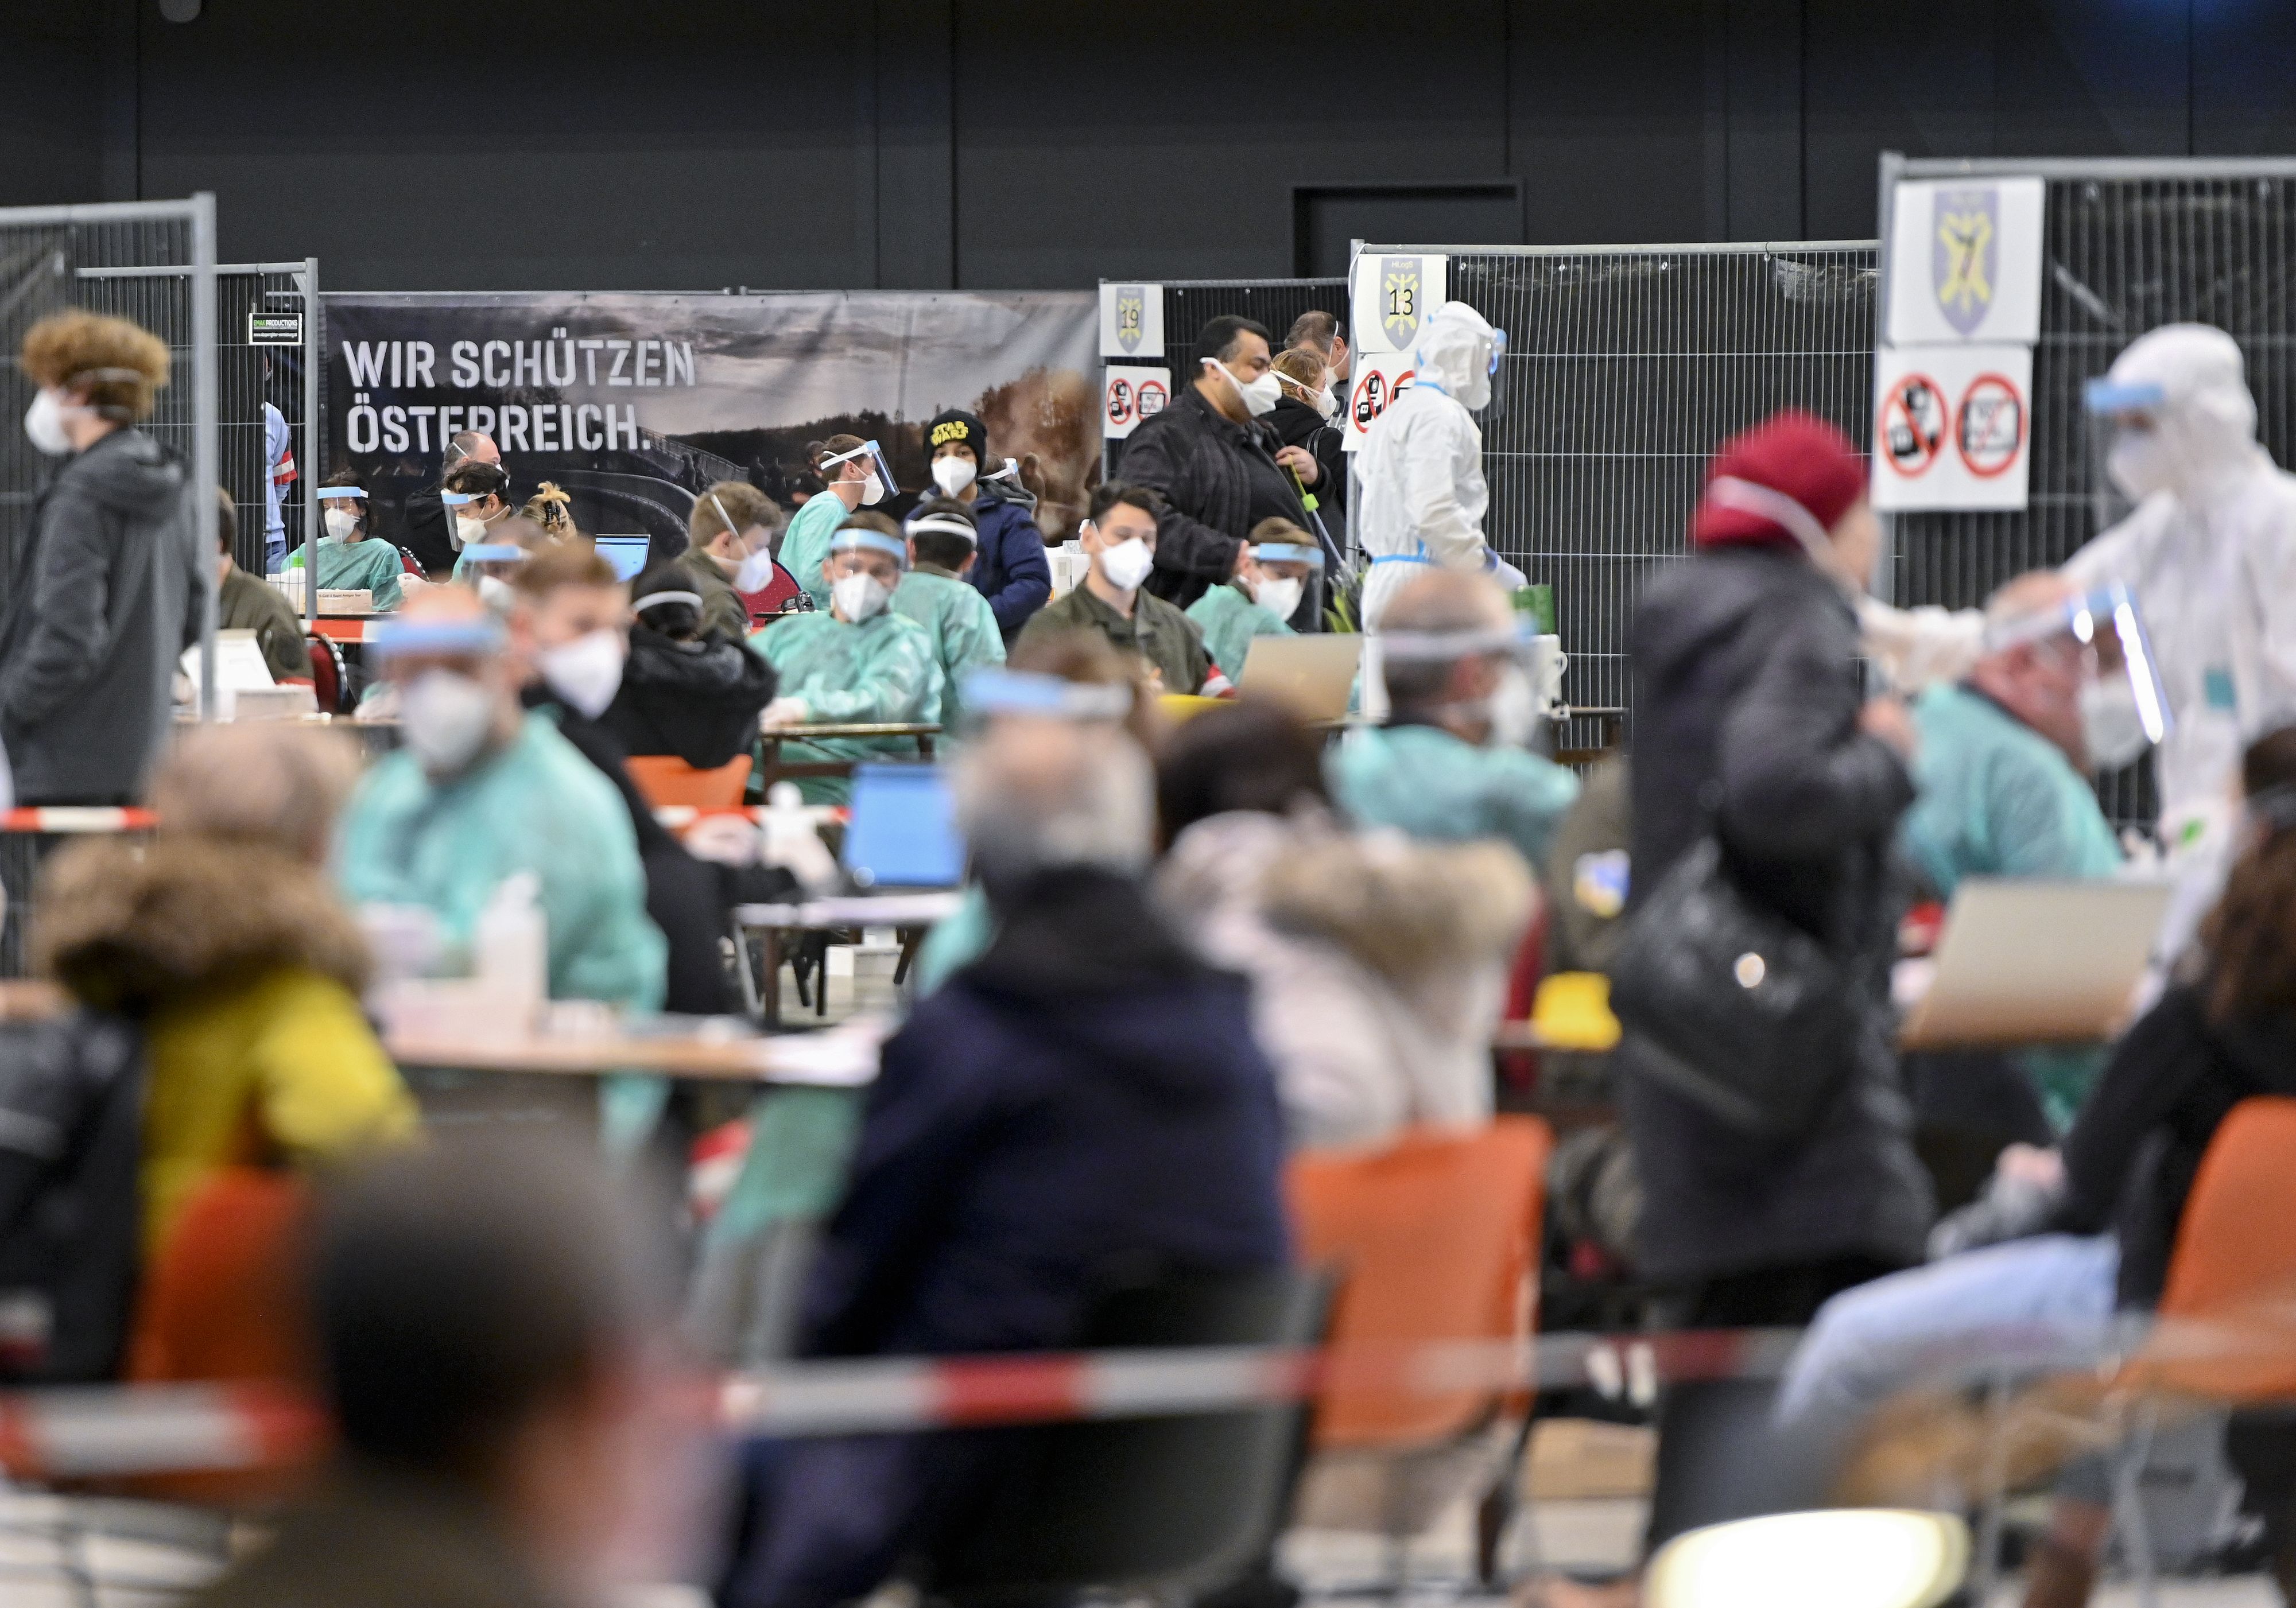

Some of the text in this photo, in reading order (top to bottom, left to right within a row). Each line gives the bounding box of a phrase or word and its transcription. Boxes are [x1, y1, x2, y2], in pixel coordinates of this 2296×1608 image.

[1389, 288, 1414, 316] 13
[1122, 308, 1139, 329] 19
[342, 327, 696, 389] WIR SCHÜTZEN
[933, 421, 968, 434] STAR
[930, 430, 968, 447] WARS
